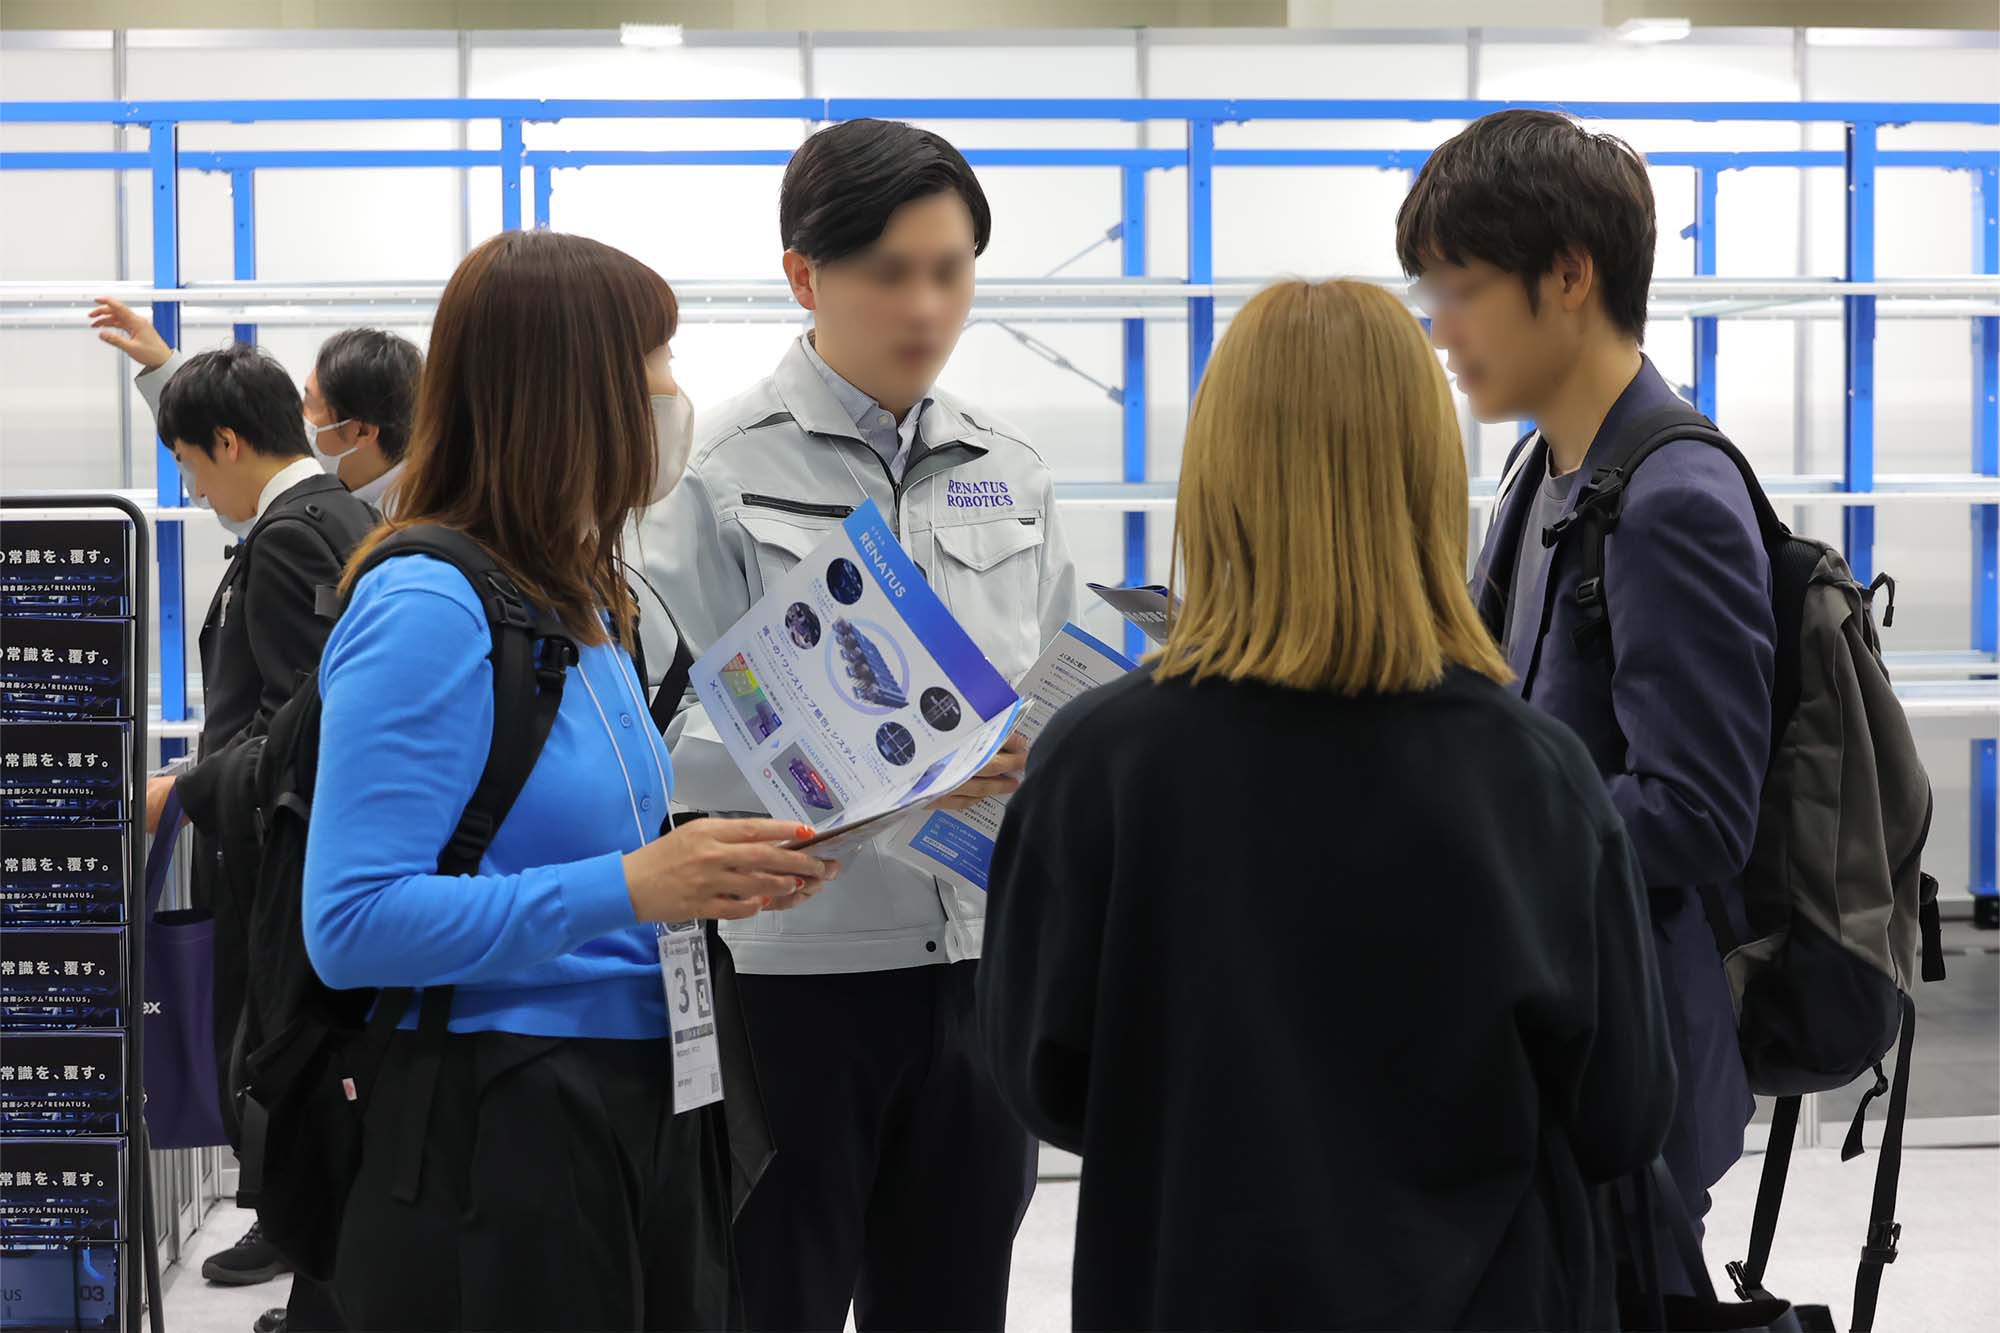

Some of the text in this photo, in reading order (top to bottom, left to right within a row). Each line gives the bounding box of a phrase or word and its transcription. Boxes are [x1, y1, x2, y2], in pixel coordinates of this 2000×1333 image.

[947, 480, 1009, 494] RENATUS
[946, 494, 1014, 508] ROBOTICS
[857, 531, 907, 599] RENATUS
[0, 647, 109, 665] 常識を、覆す。
[0, 753, 109, 768] 常識を、覆す。
[1, 961, 106, 976] 常識を、覆す。
[674, 967, 690, 1014] 3
[0, 1065, 107, 1080] 常識を、覆す。
[0, 1171, 104, 1187] 常識を、覆す。
